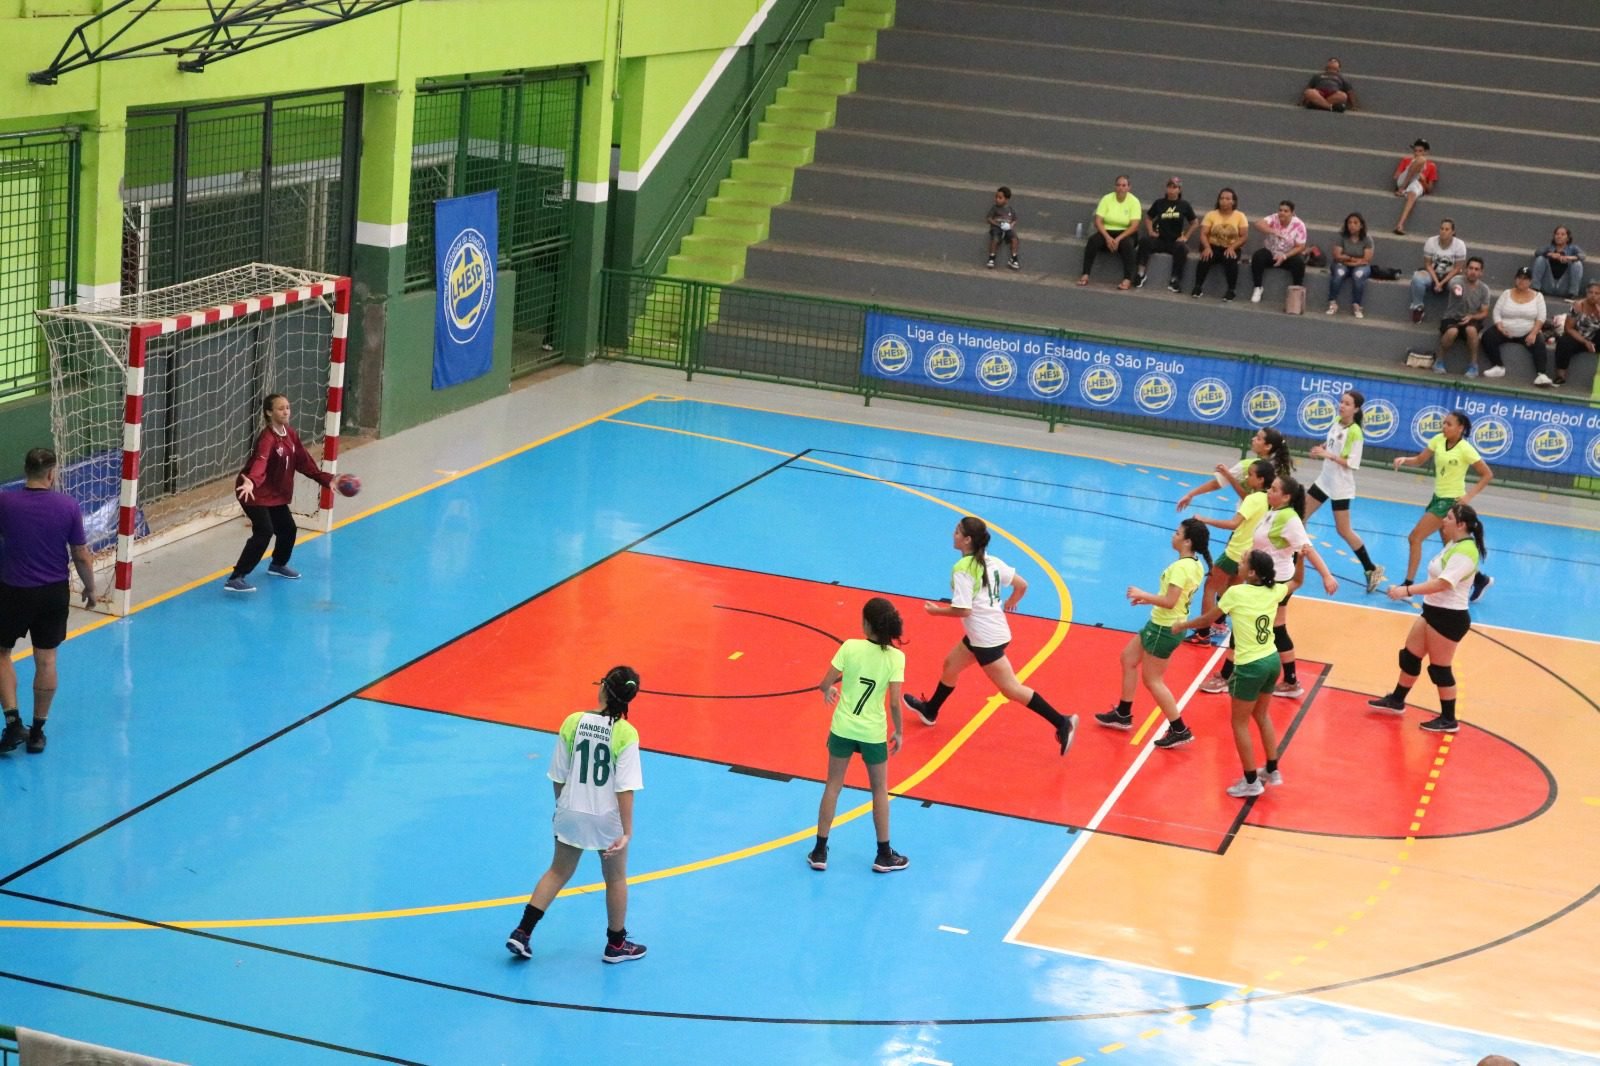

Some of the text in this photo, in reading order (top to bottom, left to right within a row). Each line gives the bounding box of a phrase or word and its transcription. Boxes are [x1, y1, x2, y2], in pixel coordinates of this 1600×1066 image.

[468, 233, 482, 250] Estado
[452, 264, 482, 300] LHESP
[879, 349, 904, 358] LHESP
[907, 324, 1184, 375] Liga de Handebol do Estado de São Paulo
[932, 357, 957, 367] LHESP
[983, 366, 1008, 374] LHESP
[1034, 370, 1060, 380] LHESP
[1088, 378, 1113, 388] LHESP
[1301, 376, 1353, 395] LHESP
[1142, 386, 1168, 396] LHESP
[1197, 392, 1223, 402] LHESP
[1252, 400, 1276, 410] LHESP
[1306, 408, 1334, 417] LHESP
[1456, 396, 1485, 415] Liga
[1490, 402, 1508, 417] de
[1512, 405, 1583, 427] Handebol
[1362, 414, 1390, 424] LHESP
[1419, 421, 1443, 430] LHES
[1476, 430, 1504, 441] LHESP
[1535, 438, 1564, 449] LHESP
[1255, 614, 1271, 645] 8
[852, 676, 876, 716] 7
[576, 738, 611, 787] 18
